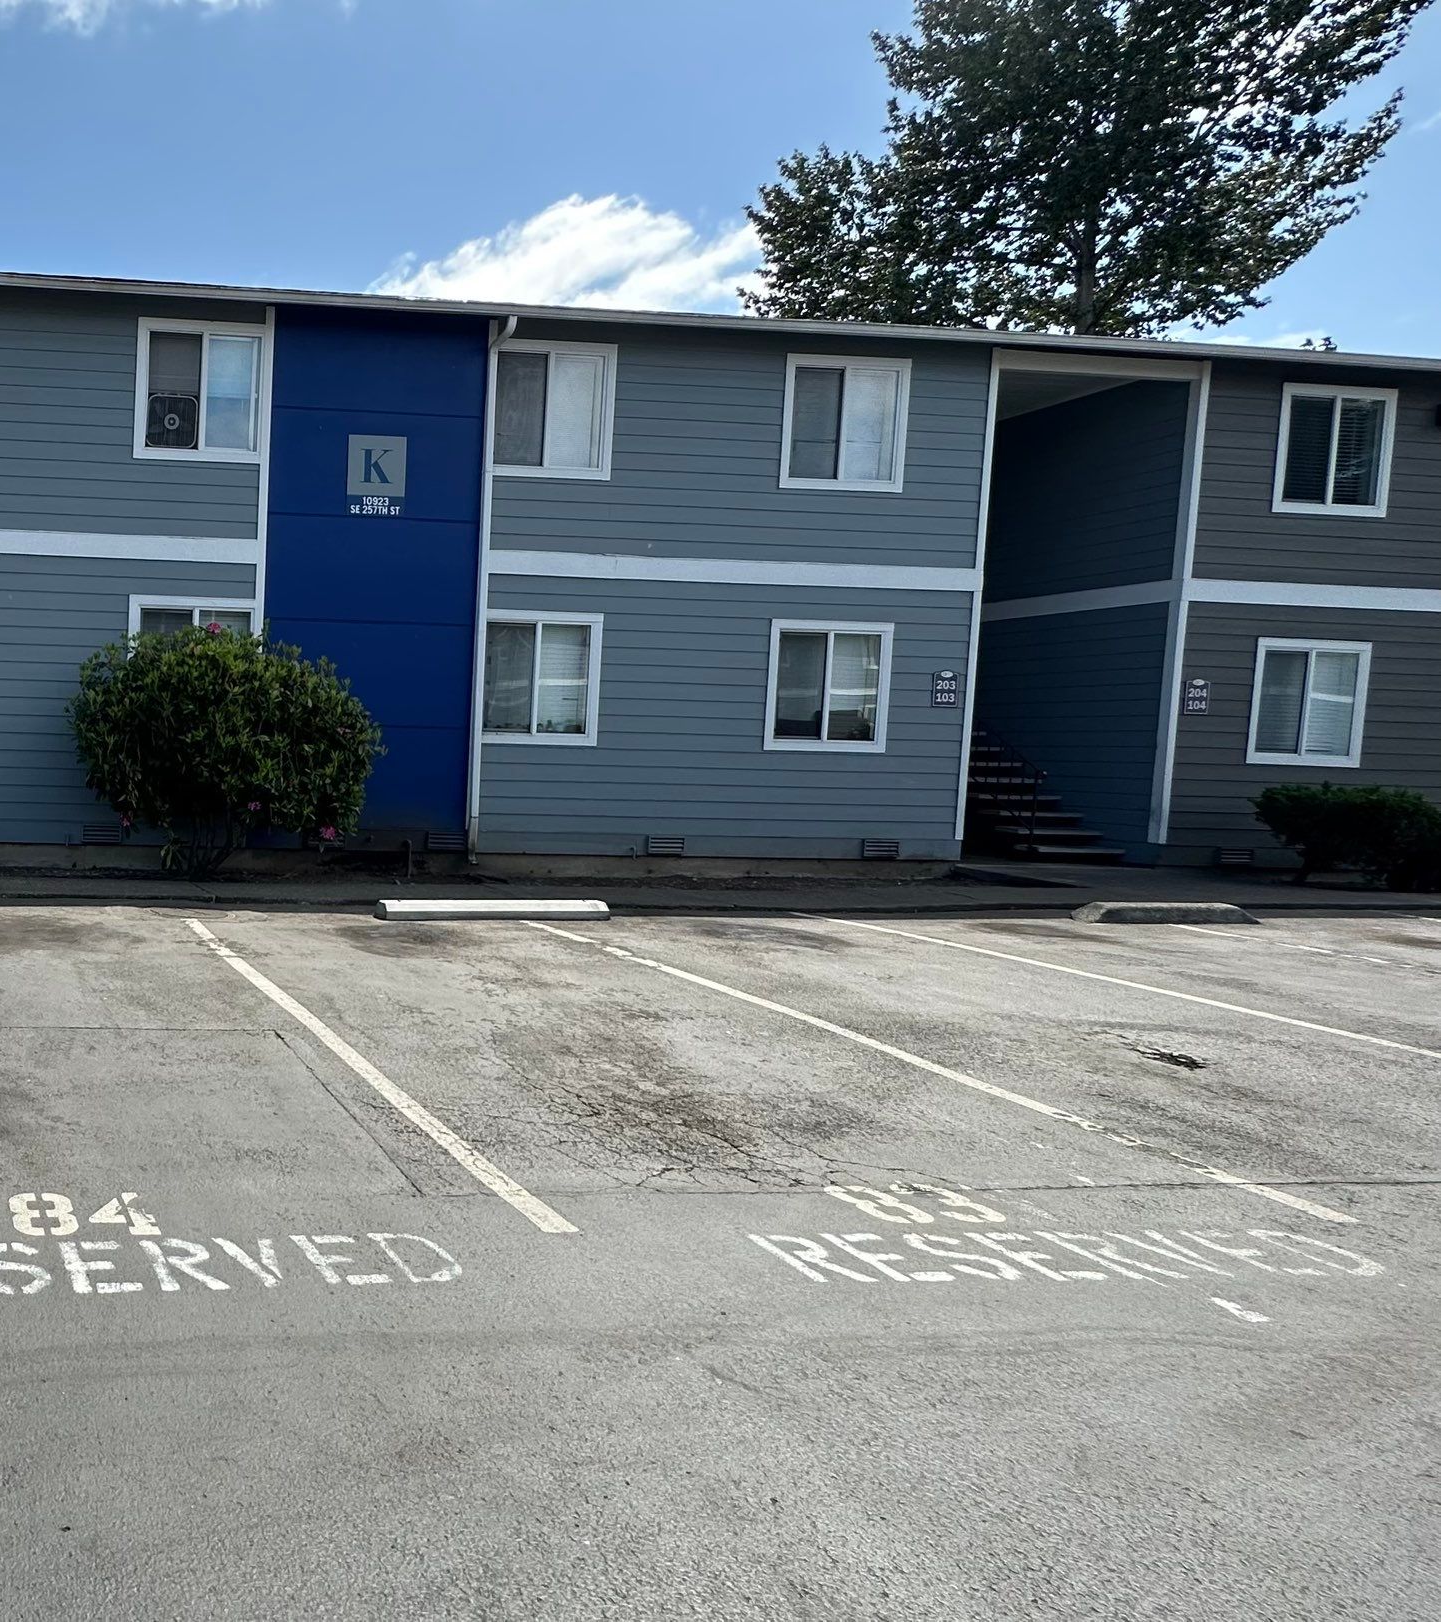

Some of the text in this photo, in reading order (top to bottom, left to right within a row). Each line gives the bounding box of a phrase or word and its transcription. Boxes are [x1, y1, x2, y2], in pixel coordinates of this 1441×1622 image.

[360, 448, 394, 484] K
[362, 496, 389, 506] 10923
[350, 505, 400, 515] SE 257TH ST
[936, 680, 956, 690] 203
[935, 692, 955, 702] 103
[1188, 688, 1207, 698] 204
[1187, 700, 1207, 710] 104
[8, 1192, 162, 1237] 84
[747, 1229, 1386, 1287] RESERVED
